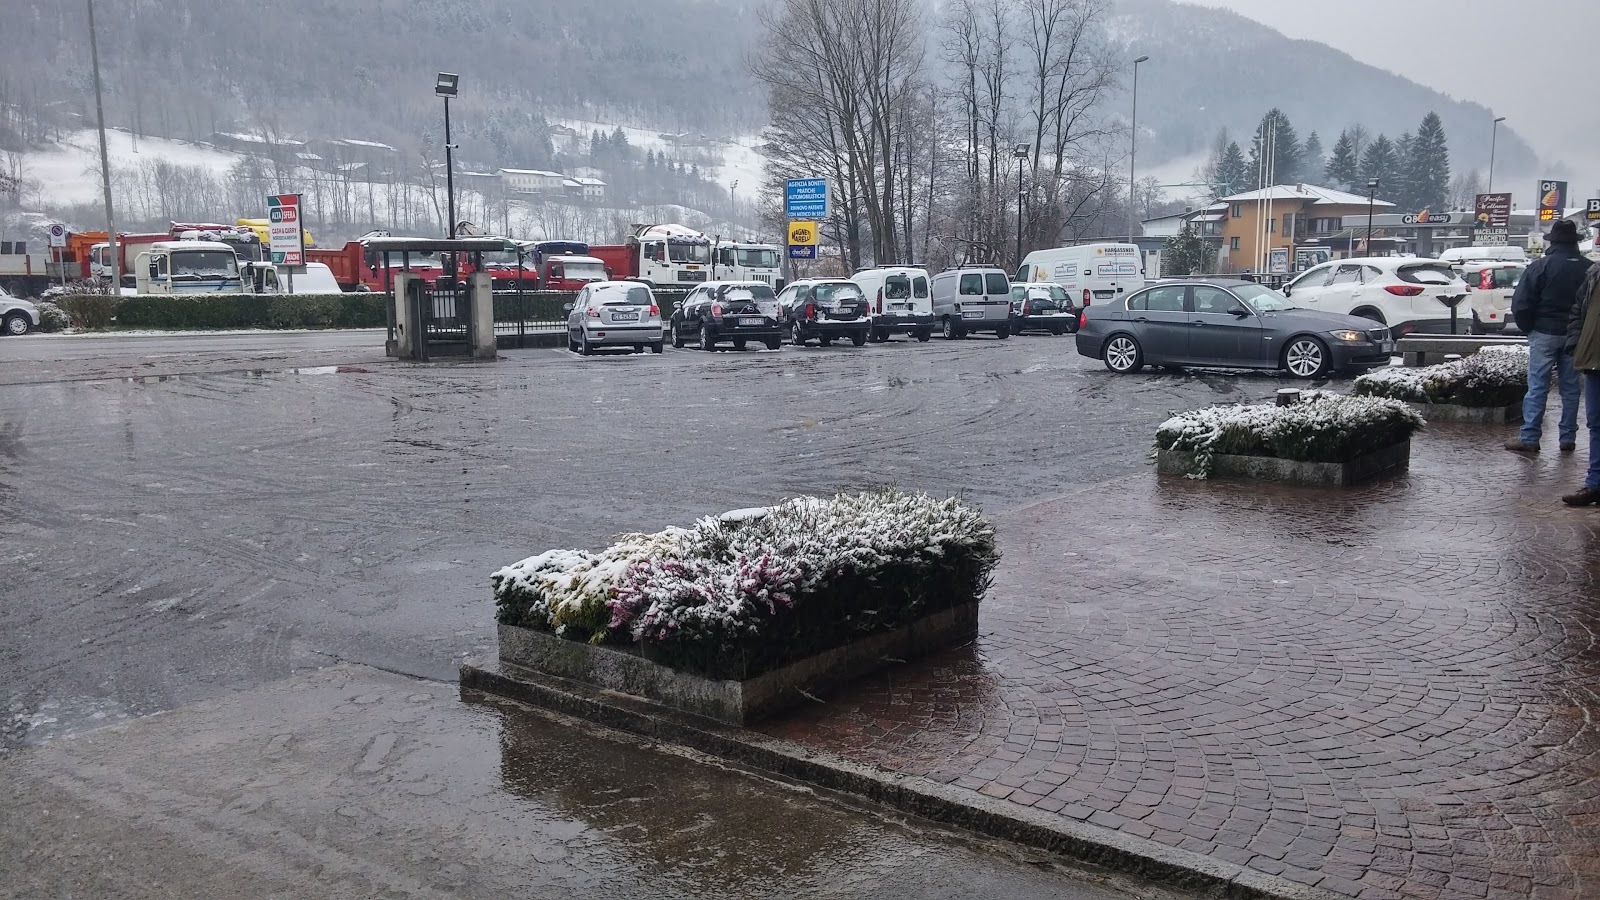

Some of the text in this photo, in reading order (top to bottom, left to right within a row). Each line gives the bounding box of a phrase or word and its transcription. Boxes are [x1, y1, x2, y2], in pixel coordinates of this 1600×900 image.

[1542, 182, 1557, 191] Q8
[1480, 195, 1506, 203] Pacific
[272, 210, 296, 220] ALTA SFERA
[1404, 215, 1418, 223] Q8
